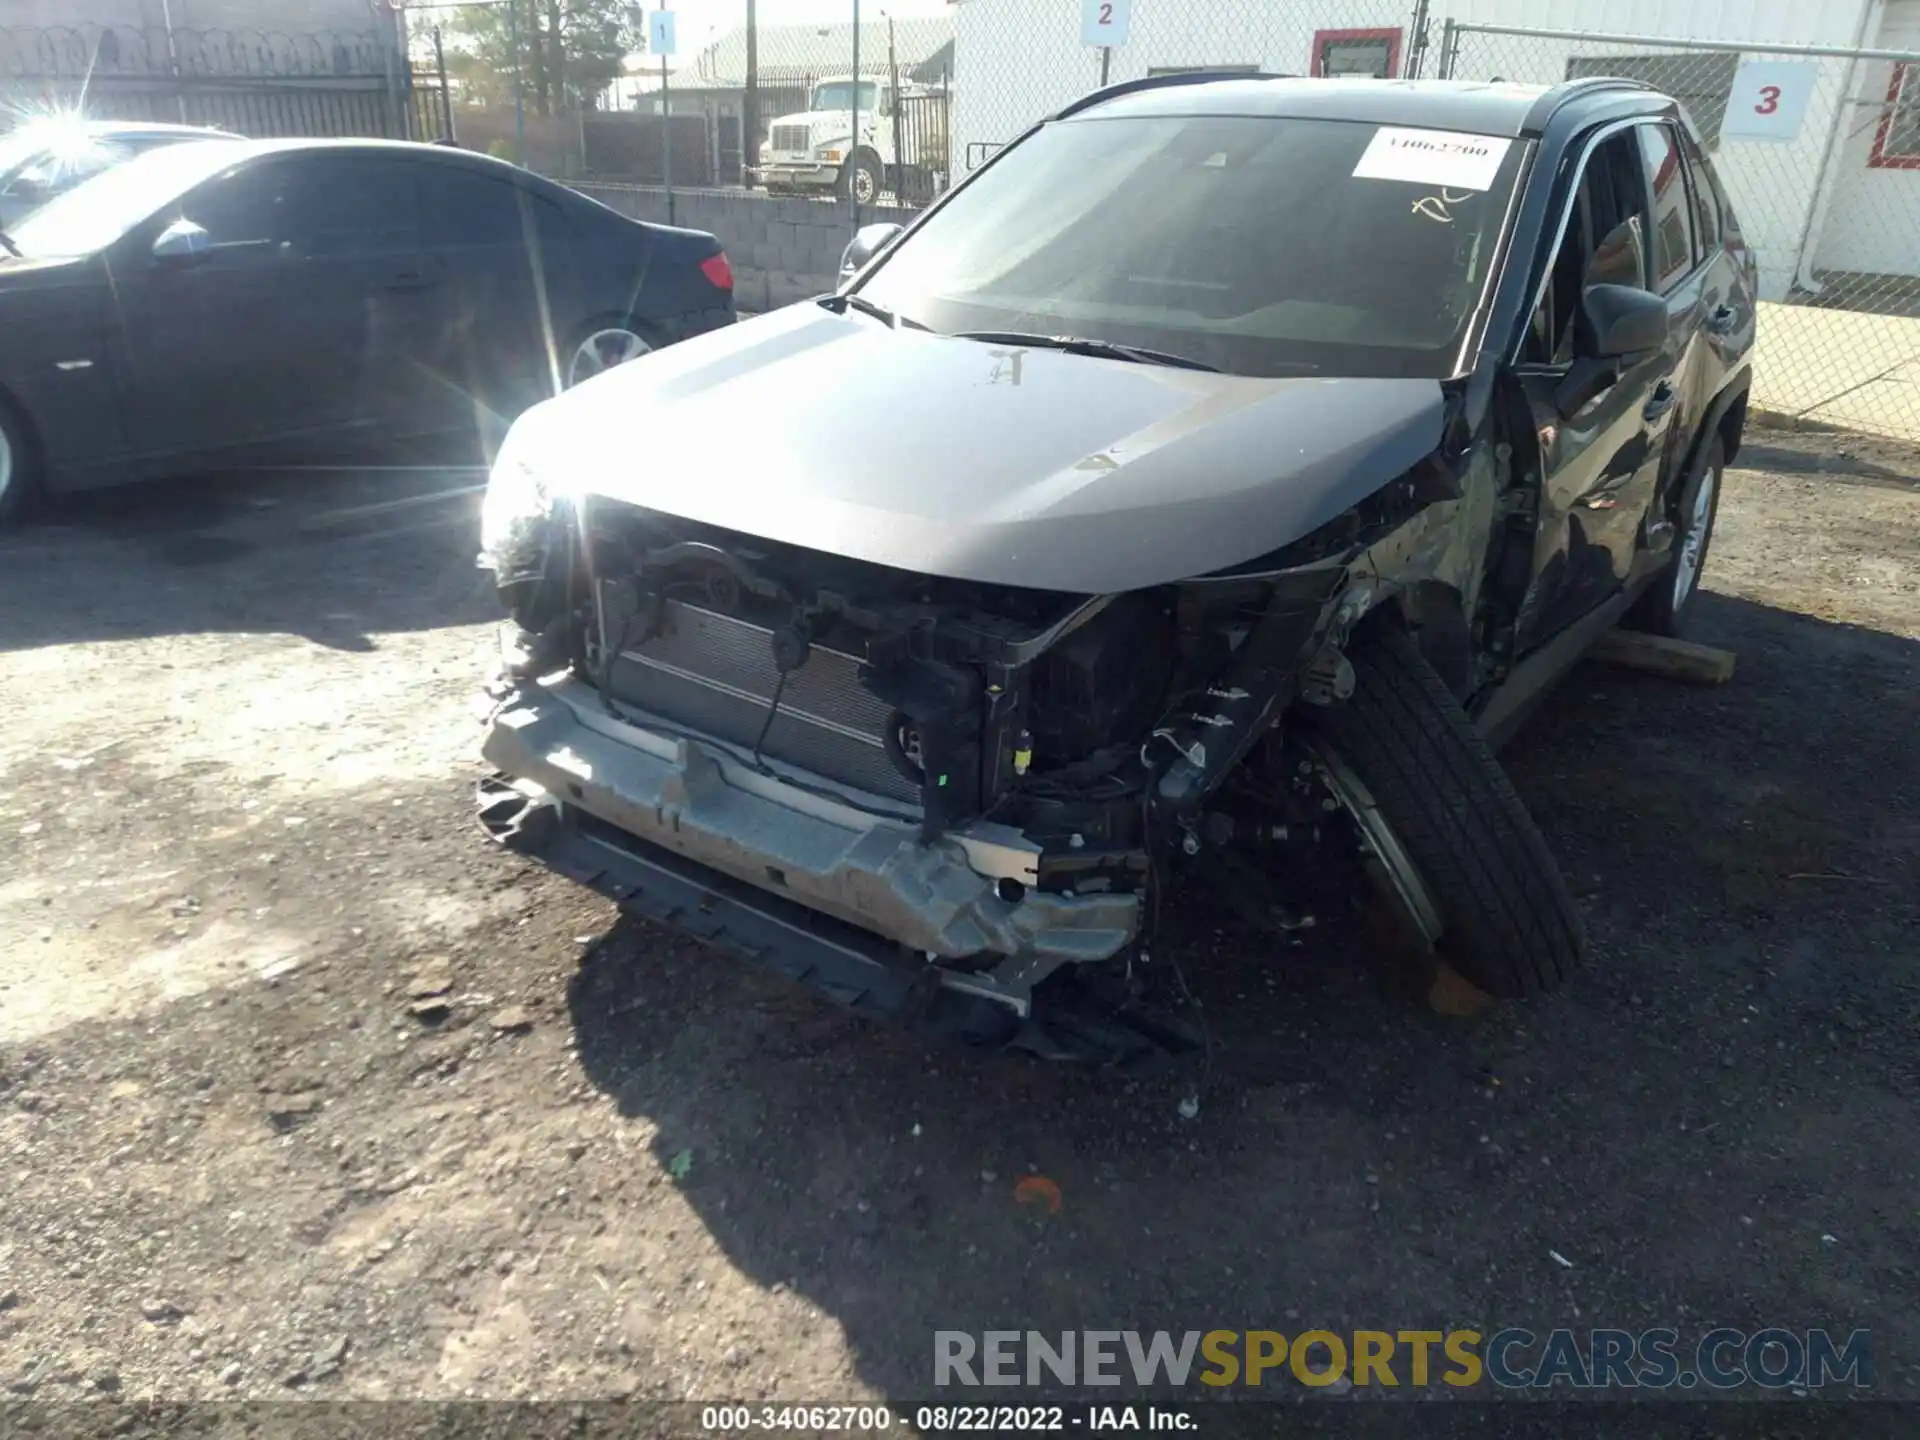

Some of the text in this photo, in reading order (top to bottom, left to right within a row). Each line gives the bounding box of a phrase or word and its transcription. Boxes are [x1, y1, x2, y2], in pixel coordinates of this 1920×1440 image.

[1098, 3, 1112, 24] 2
[660, 23, 666, 40] 1
[1754, 86, 1781, 114] 3
